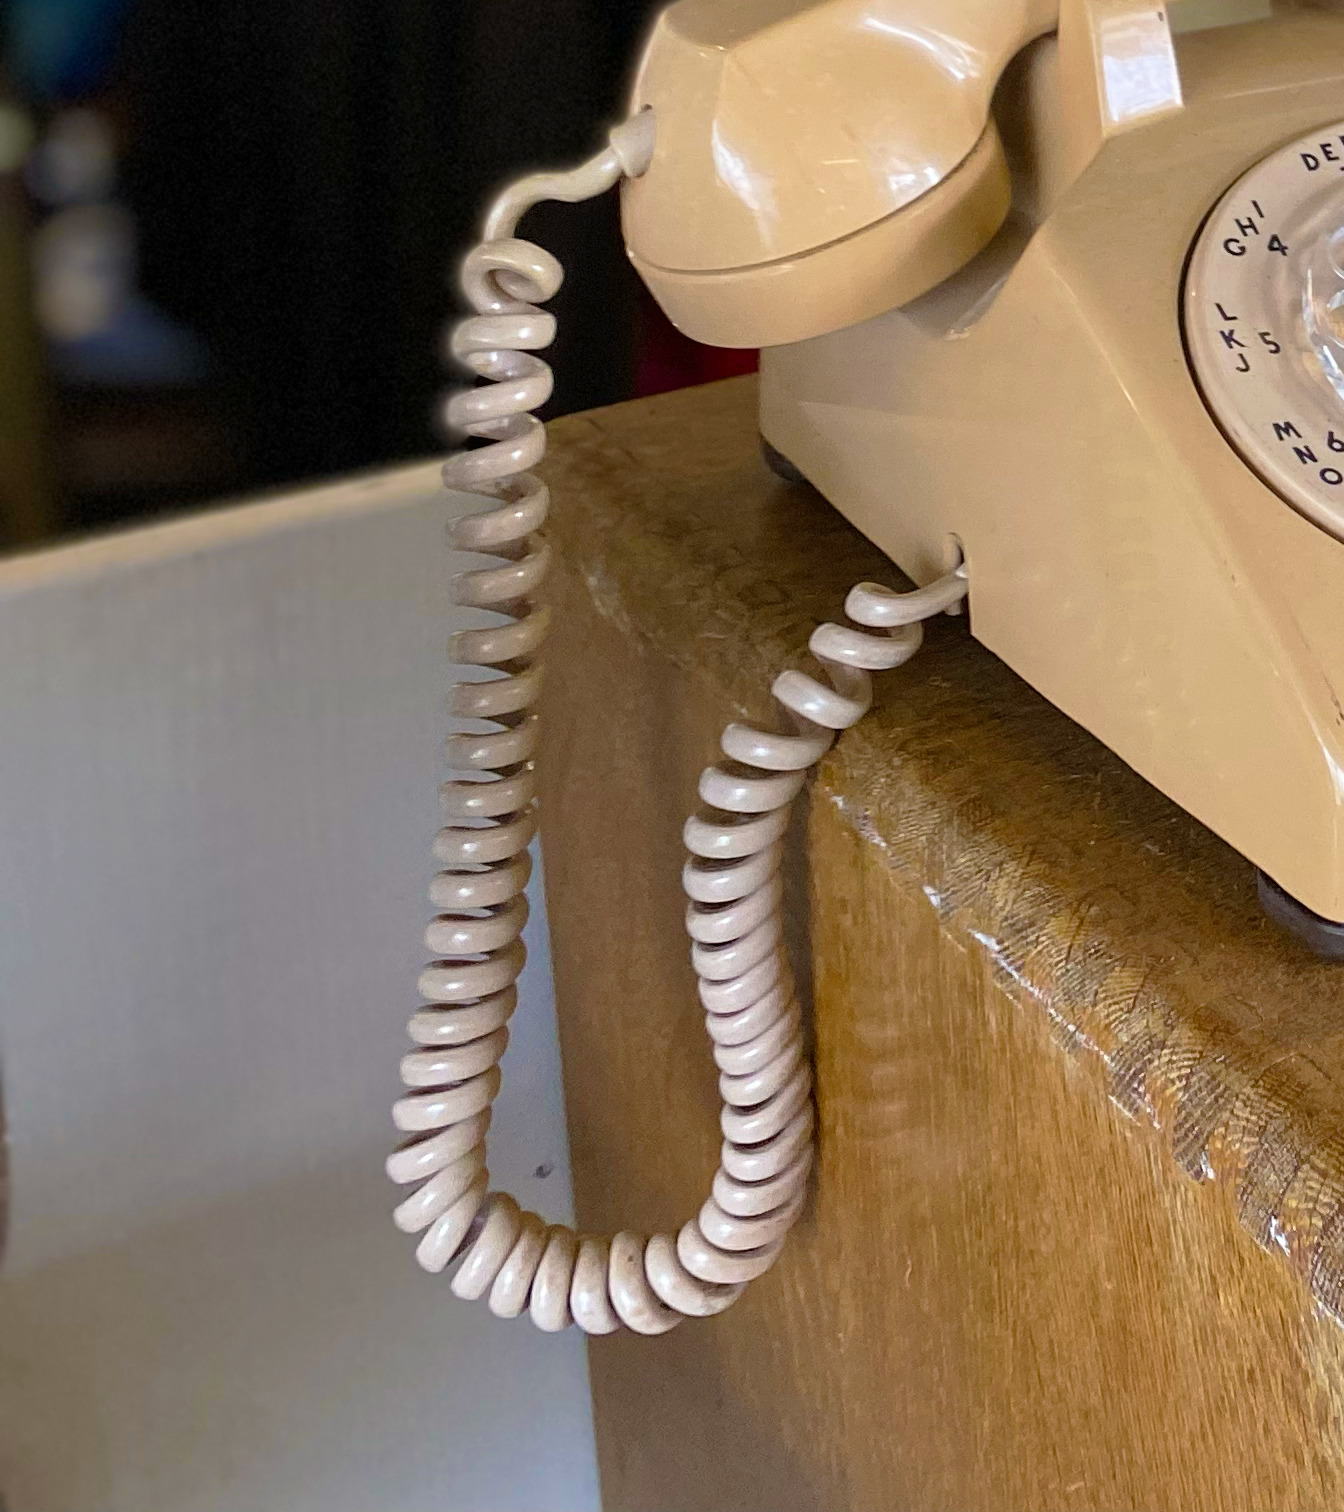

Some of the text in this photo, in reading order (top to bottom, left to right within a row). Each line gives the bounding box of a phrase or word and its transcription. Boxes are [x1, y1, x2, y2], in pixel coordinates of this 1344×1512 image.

[1222, 199, 1265, 257] GHI
[1267, 234, 1289, 257] 4
[1258, 332, 1282, 355] 5
[1272, 420, 1344, 487] MNO
